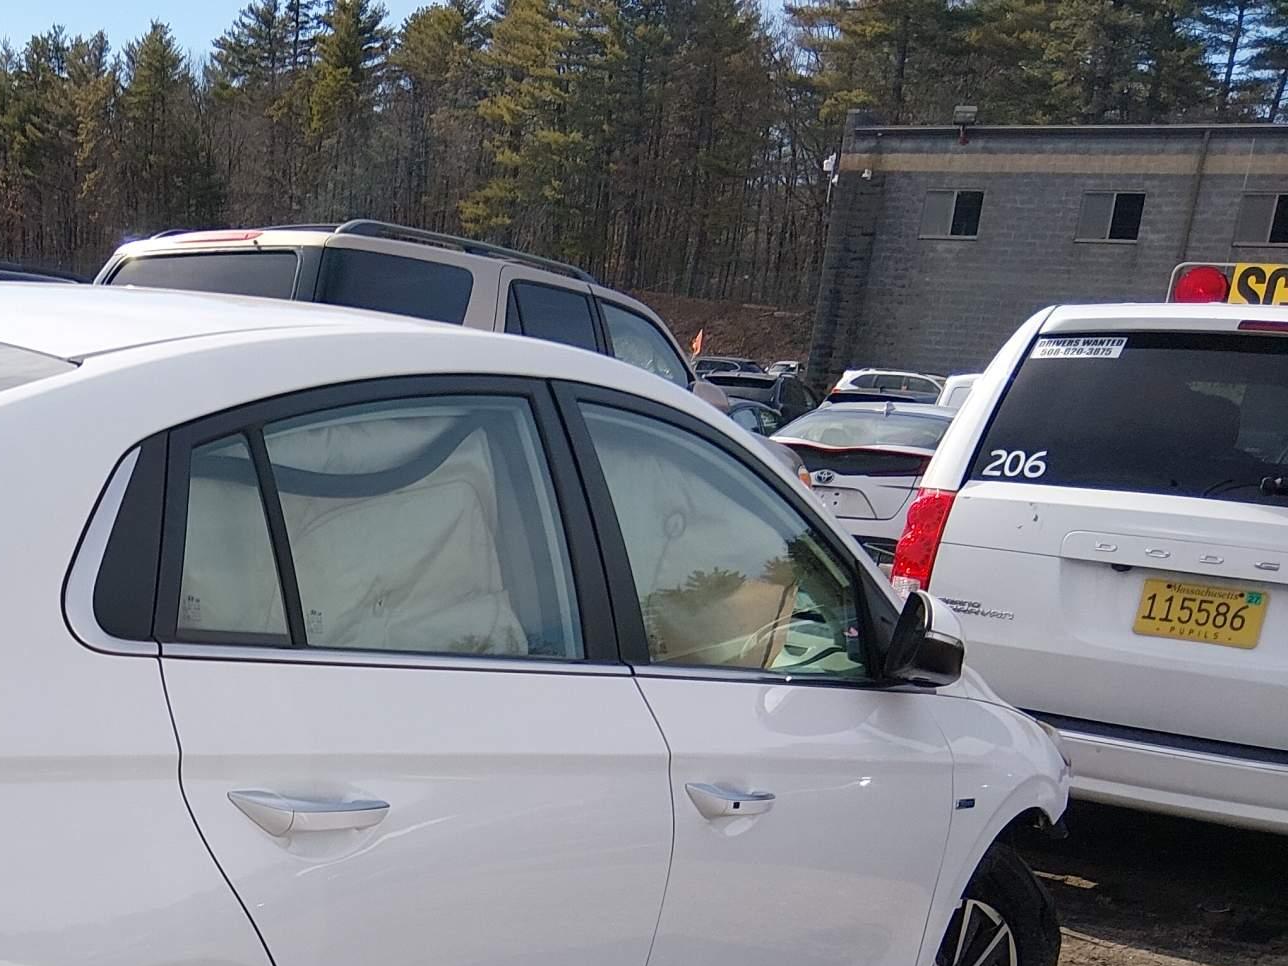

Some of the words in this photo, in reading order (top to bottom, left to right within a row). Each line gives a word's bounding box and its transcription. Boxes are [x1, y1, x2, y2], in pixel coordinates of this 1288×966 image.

[1038, 339, 1080, 348] DRIVERS
[1081, 338, 1125, 347] WANTED
[981, 449, 1047, 479] 206
[1141, 592, 1250, 632] 115586
[1168, 626, 1219, 640] PUPILS
